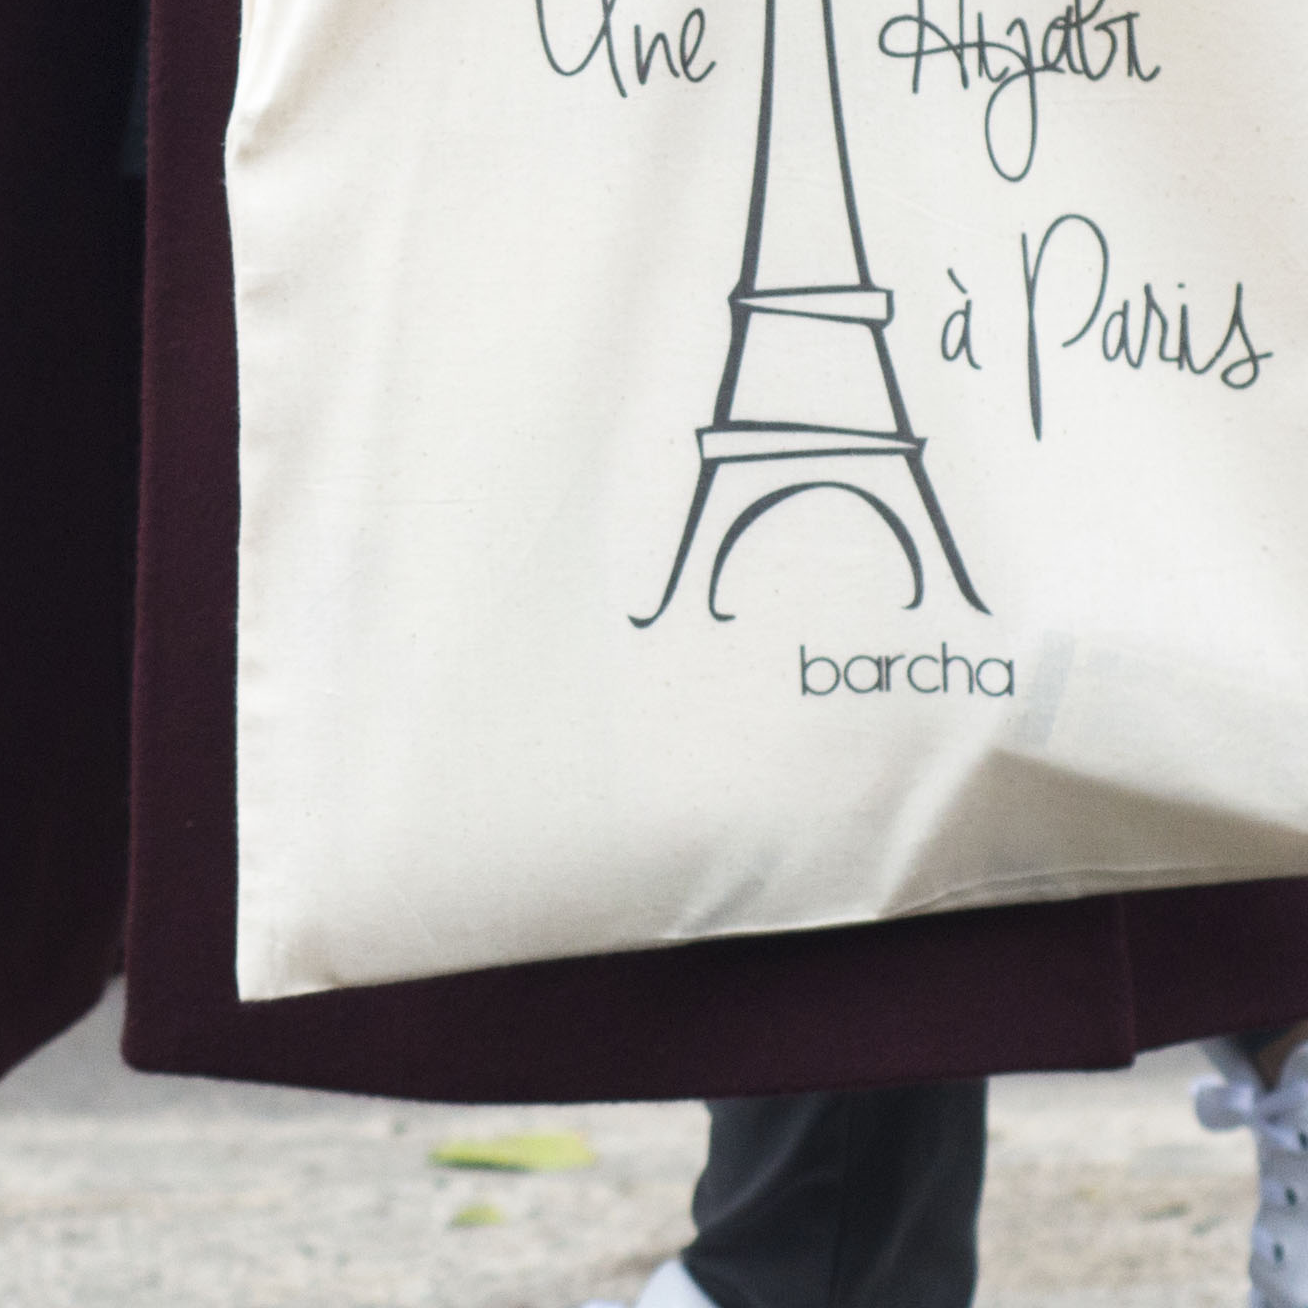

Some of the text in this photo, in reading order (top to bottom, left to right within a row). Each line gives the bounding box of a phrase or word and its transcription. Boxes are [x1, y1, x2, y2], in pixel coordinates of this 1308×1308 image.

[940, 213, 1275, 441] à Paris
[799, 643, 1014, 697] barcha
